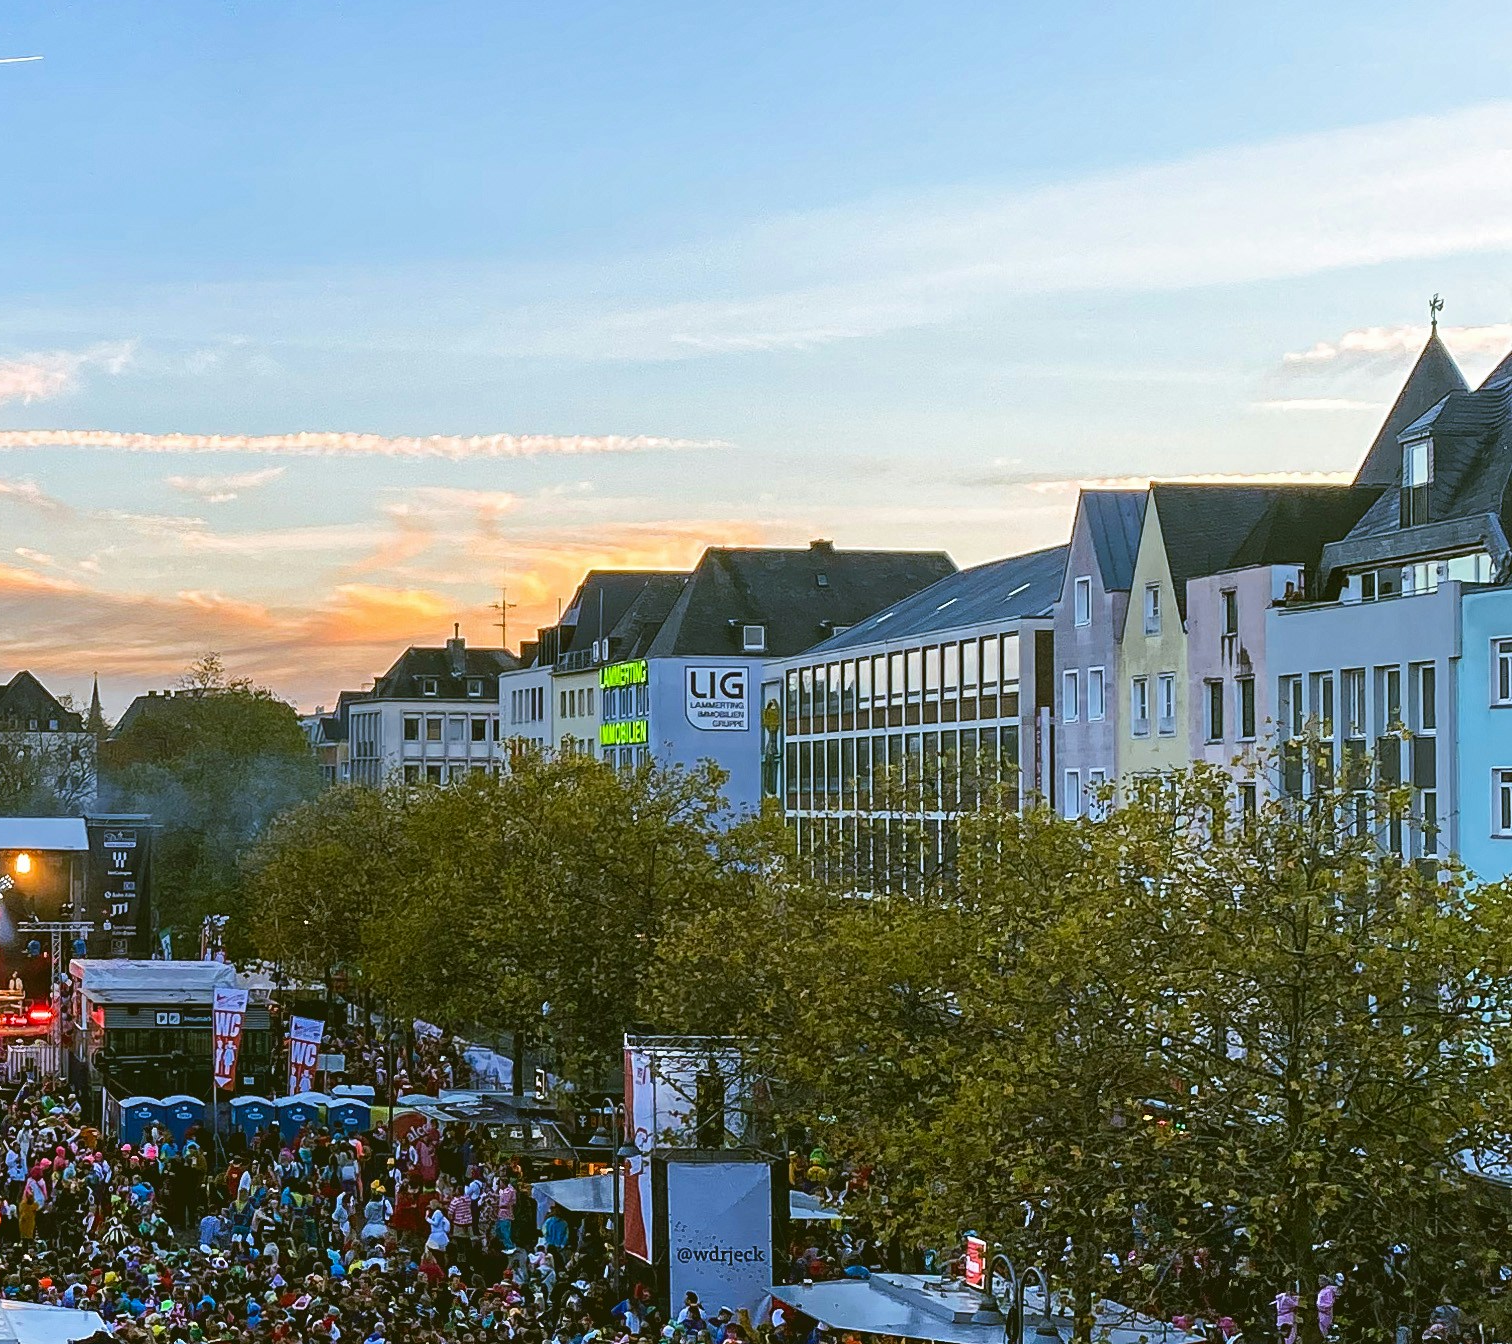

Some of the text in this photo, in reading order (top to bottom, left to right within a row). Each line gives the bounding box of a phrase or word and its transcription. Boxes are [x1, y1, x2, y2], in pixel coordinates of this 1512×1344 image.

[690, 671, 744, 699] LIG
[690, 701, 745, 709] LAMMERTING
[698, 711, 745, 719] IMMOBILIEN
[214, 1011, 242, 1038] WC
[291, 1040, 317, 1067] WC
[676, 1246, 767, 1267] @wdrjeck
